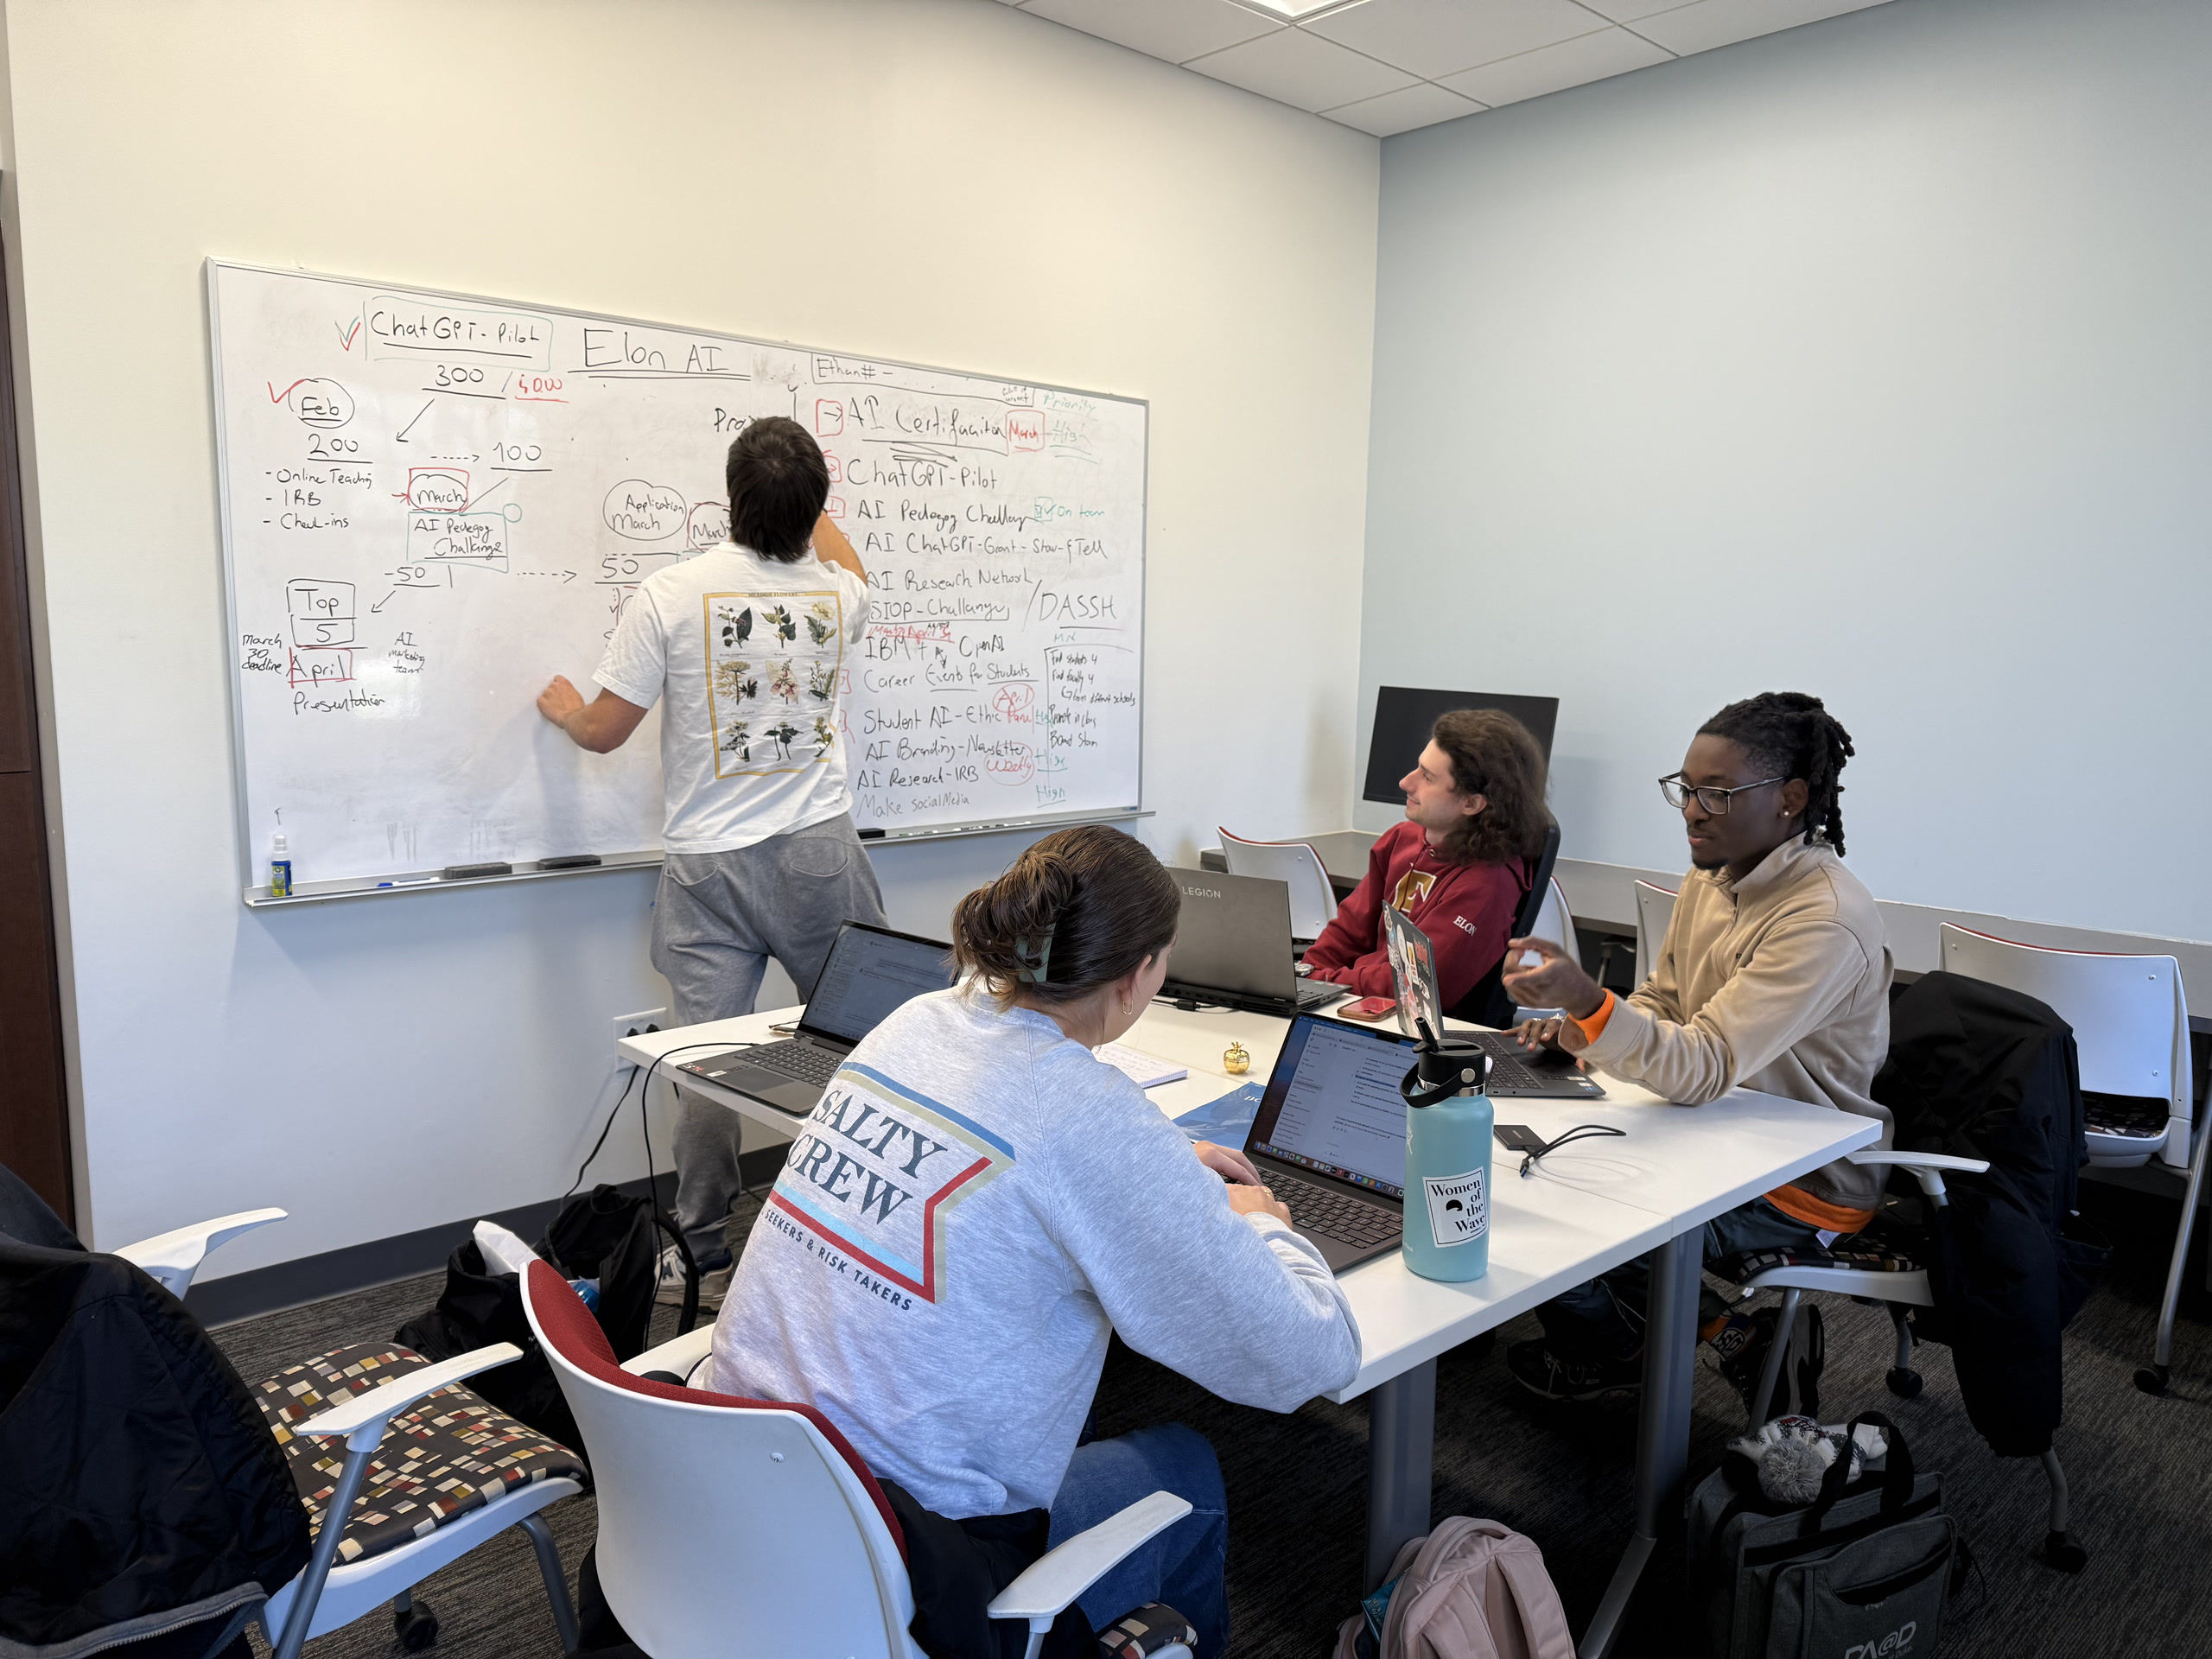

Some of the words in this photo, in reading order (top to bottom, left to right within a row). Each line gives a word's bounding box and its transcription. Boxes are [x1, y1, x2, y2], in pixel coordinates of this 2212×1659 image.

[584, 327, 666, 370] Elon
[686, 344, 729, 373] AI
[435, 365, 484, 386] 300
[302, 397, 340, 416] Feb
[847, 395, 885, 430] AI
[1044, 390, 1096, 416] Priority
[308, 434, 359, 457] 200
[493, 442, 542, 462] 100
[276, 468, 327, 484] Online
[284, 489, 321, 506] IRB
[417, 489, 467, 505] March
[626, 494, 684, 514] Application
[858, 499, 886, 519] AI
[414, 518, 440, 532] AI
[612, 513, 660, 531] March
[866, 532, 895, 552] AI
[602, 558, 639, 579] 50
[866, 570, 893, 591] AI
[294, 588, 340, 616] Top
[1039, 593, 1116, 621] DASSH
[242, 633, 283, 649] March
[316, 623, 339, 642] 5
[865, 634, 911, 661] IBM
[286, 654, 346, 688] April
[988, 663, 1030, 680] Students
[293, 689, 385, 715] Presentation
[864, 709, 923, 734] Student
[865, 741, 891, 762] AI
[857, 770, 882, 791] AI
[857, 794, 904, 818] Make
[1181, 886, 1222, 899] LEGION
[1452, 915, 1478, 937] ELON
[812, 1090, 948, 1179] SALTY
[786, 1134, 913, 1225] CREW
[1430, 1179, 1481, 1197] Women
[1470, 1187, 1481, 1203] of
[1466, 1203, 1484, 1217] the
[1454, 1215, 1484, 1232] Wave
[765, 1210, 804, 1243] SEEKERS
[807, 1239, 814, 1252] &
[818, 1248, 848, 1274] RISK
[854, 1270, 912, 1311] TAKERS
